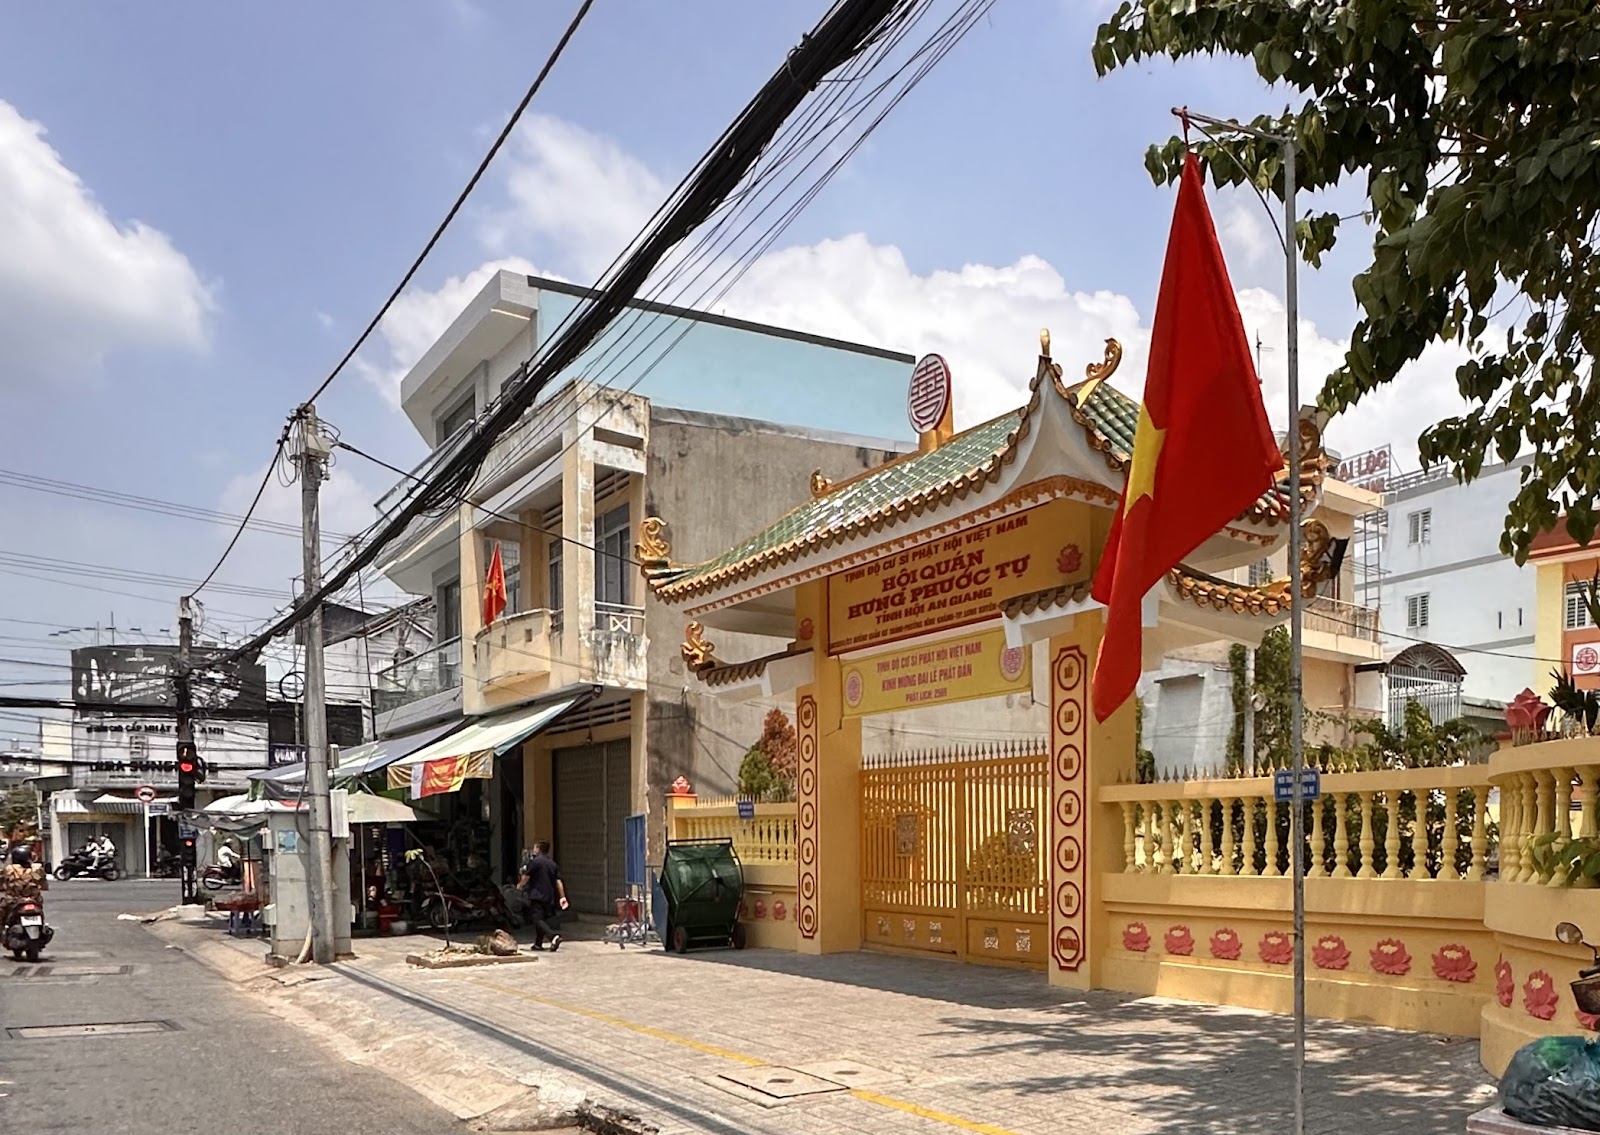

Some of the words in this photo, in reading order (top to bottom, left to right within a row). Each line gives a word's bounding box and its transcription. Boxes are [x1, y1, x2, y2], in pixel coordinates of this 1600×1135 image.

[845, 571, 865, 583] TỊNH
[867, 562, 880, 576] ĐỘ
[883, 557, 897, 570] CƯ
[912, 544, 940, 561] PHẬT
[943, 535, 962, 551] HỘI
[966, 527, 992, 542] VIỆT
[996, 515, 1028, 534] NAM
[882, 568, 918, 592] HỘI
[920, 549, 984, 580] QUÁN
[848, 591, 907, 619] HƯNG
[910, 567, 991, 603] PHƯỚC
[995, 554, 1031, 579] TỰ
[905, 602, 925, 618] HỘI
[928, 598, 947, 611] AN
[949, 587, 993, 606] GIANG
[949, 644, 963, 660] VIỆT
[965, 641, 982, 655] NAM
